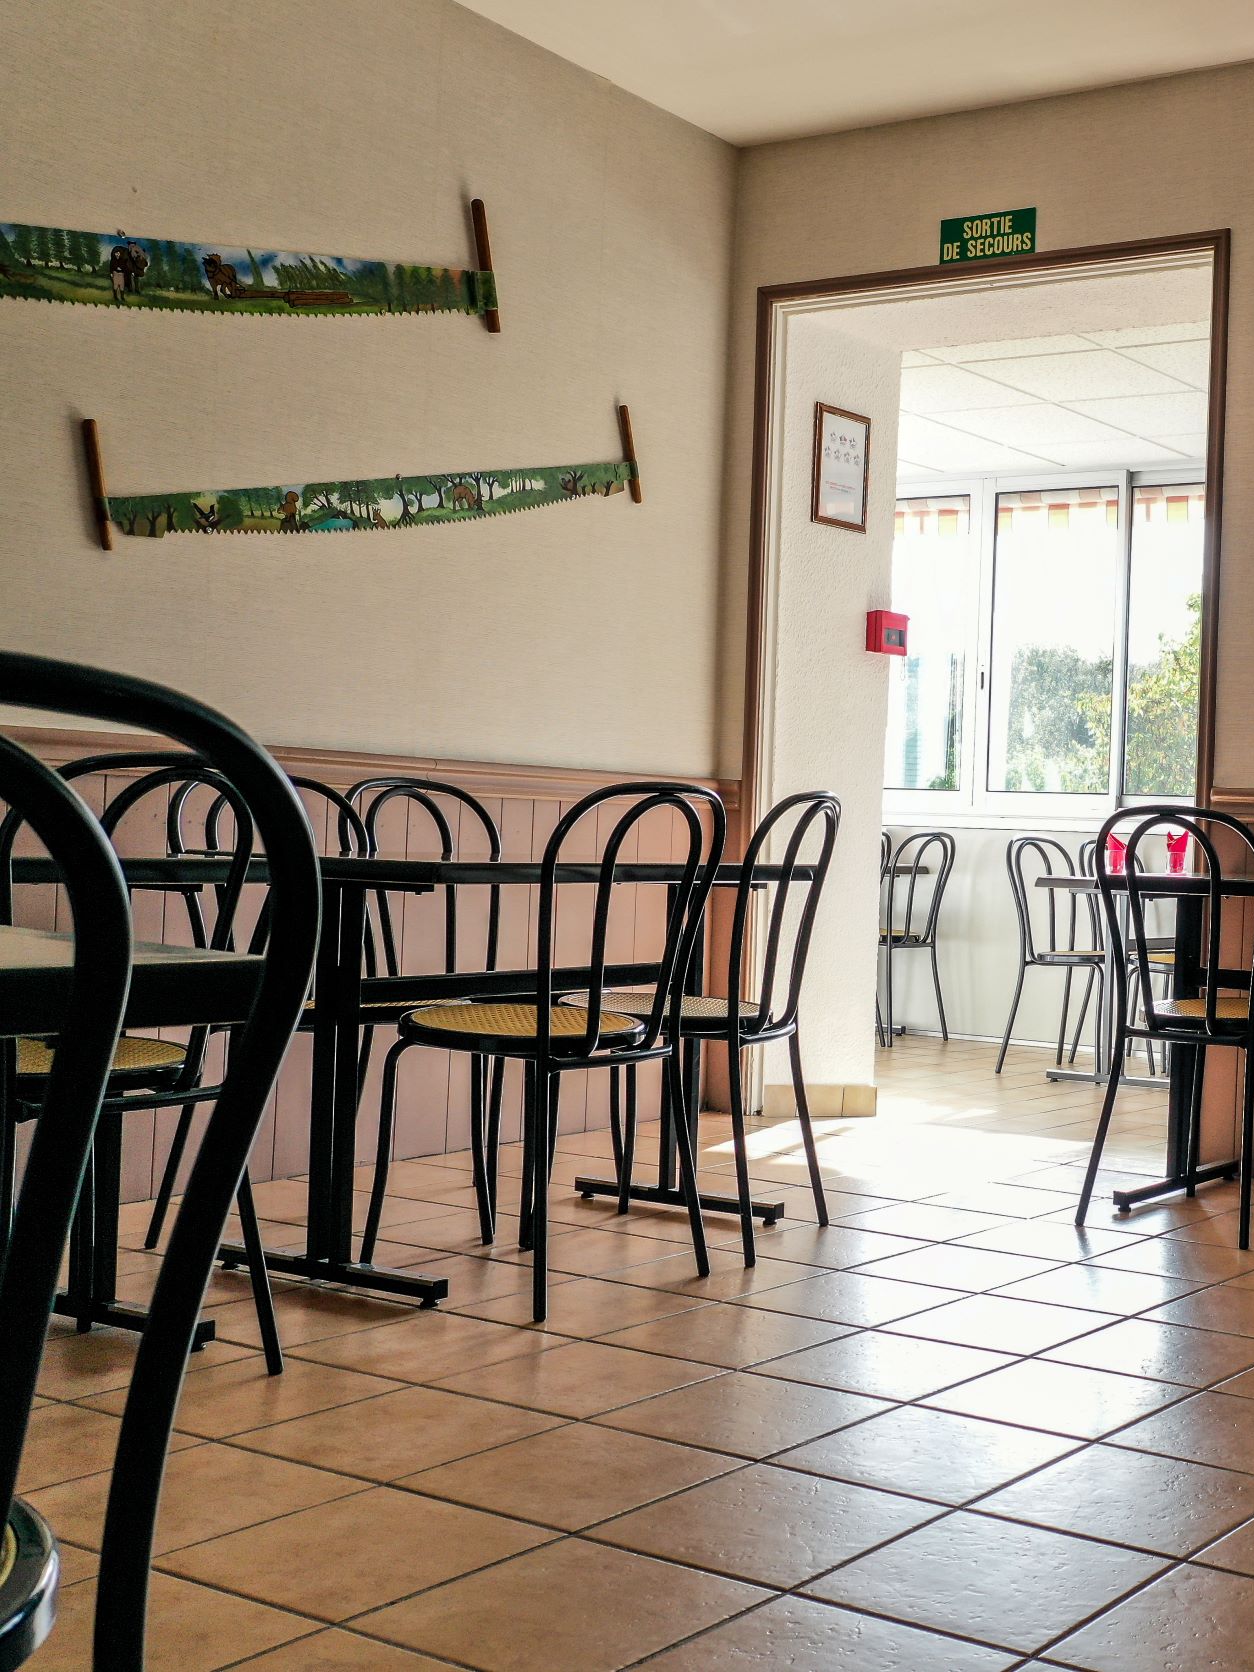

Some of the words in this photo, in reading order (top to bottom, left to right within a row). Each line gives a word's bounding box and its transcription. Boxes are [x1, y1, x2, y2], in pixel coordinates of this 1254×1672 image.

[964, 216, 1013, 238] SORTIE
[944, 242, 960, 260] DE
[968, 233, 1031, 257] SECOURS
